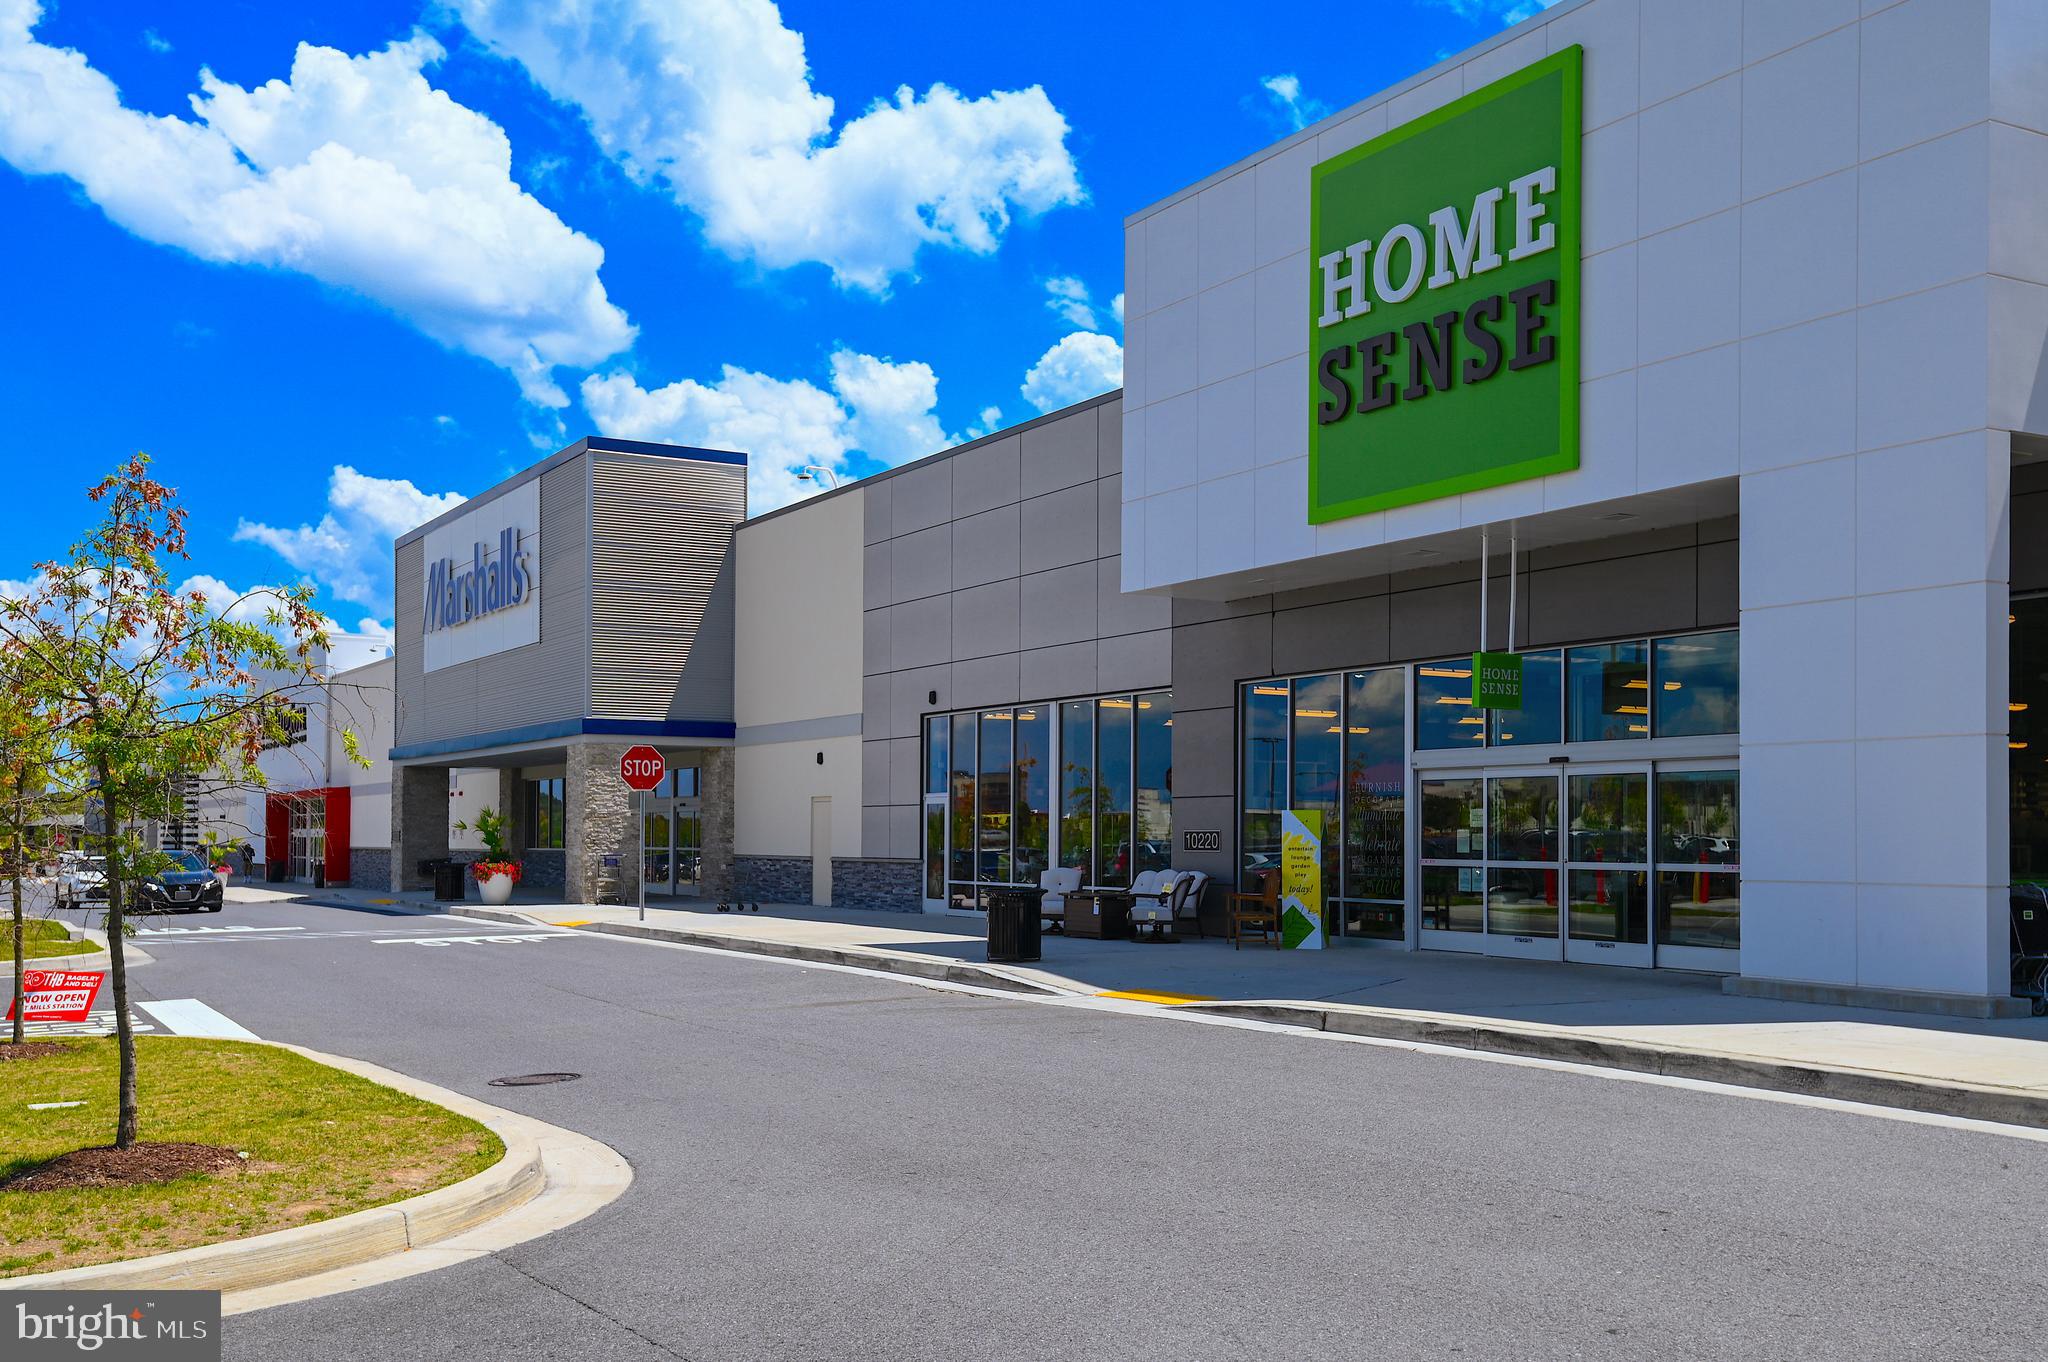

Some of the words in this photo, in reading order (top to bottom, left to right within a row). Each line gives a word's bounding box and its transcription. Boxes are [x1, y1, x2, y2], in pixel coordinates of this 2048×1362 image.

[1318, 166, 1556, 328] HOME
[1318, 279, 1556, 425] SENSE
[422, 527, 529, 635] Marshalls
[1482, 667, 1519, 680] HOME
[1481, 682, 1519, 696] SENSE
[623, 760, 661, 776] STOP
[1185, 833, 1218, 848] 10220
[1288, 884, 1314, 895] today!
[44, 972, 65, 988] THB
[54, 993, 86, 1002] OPEN
